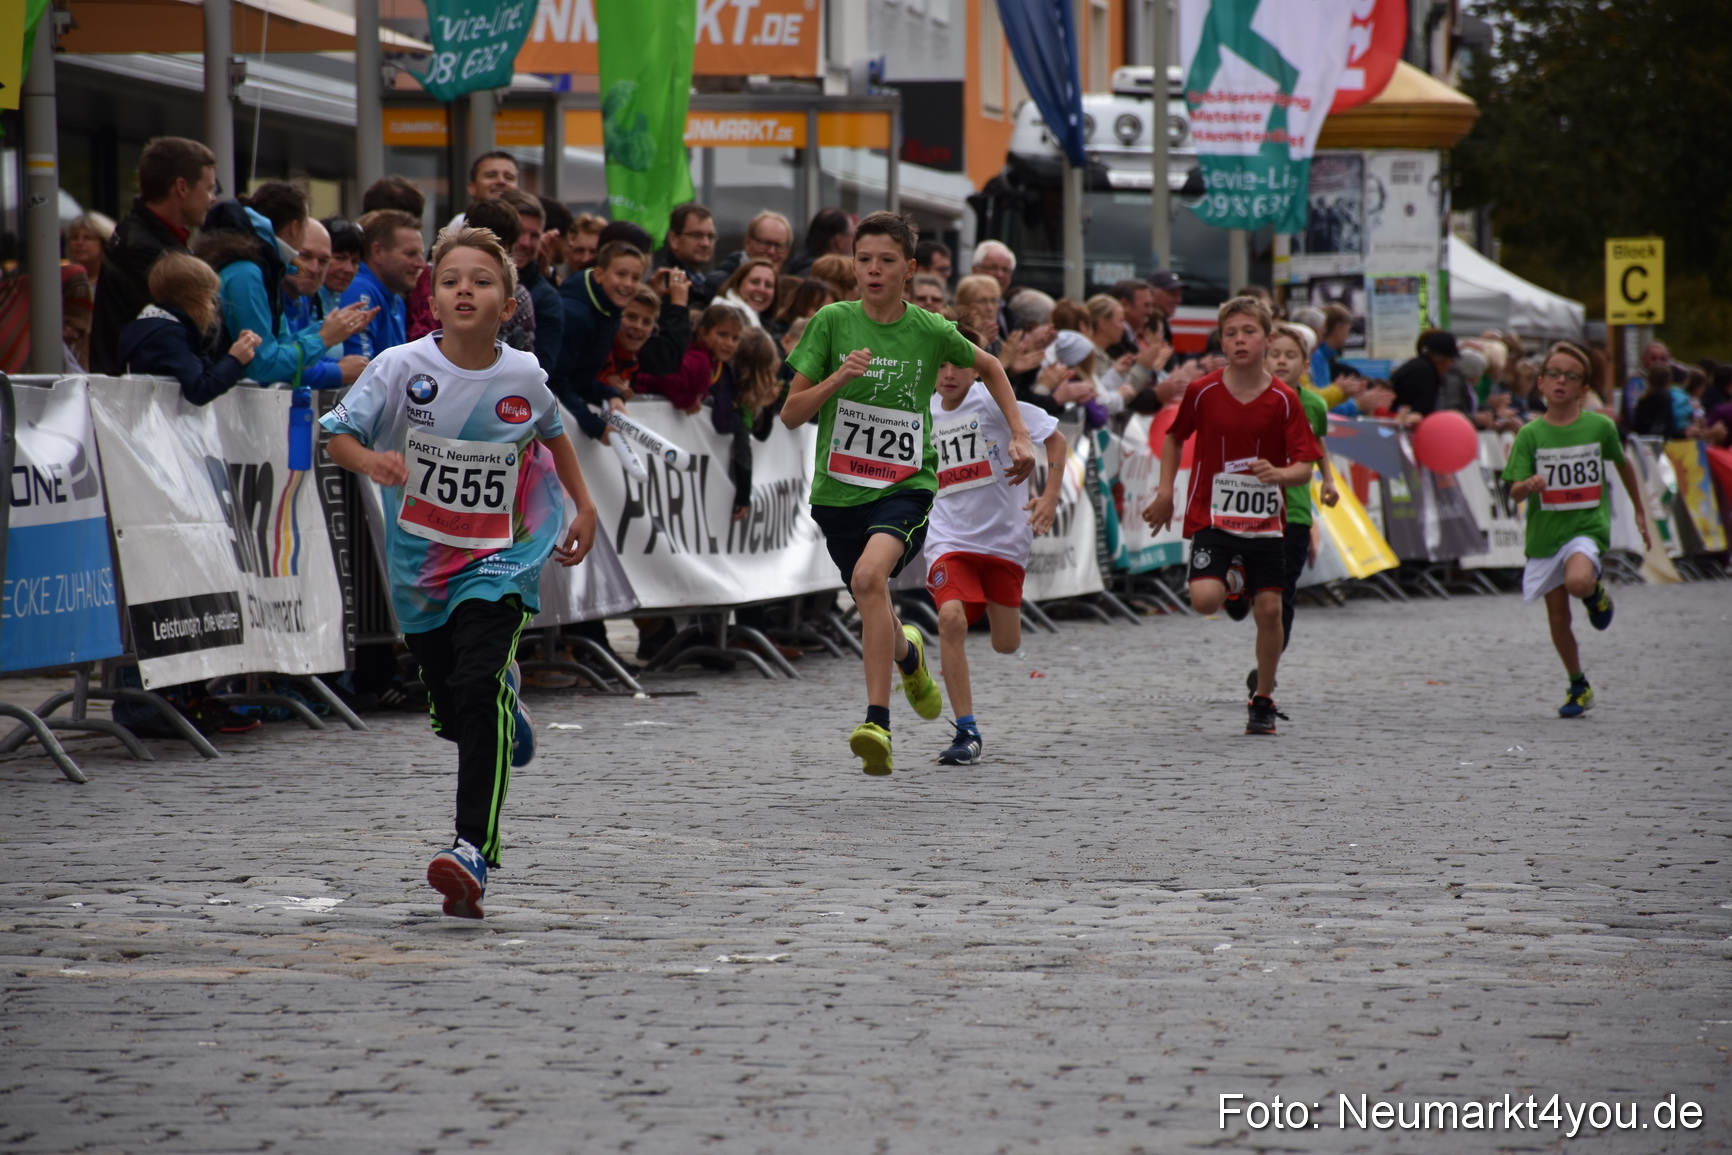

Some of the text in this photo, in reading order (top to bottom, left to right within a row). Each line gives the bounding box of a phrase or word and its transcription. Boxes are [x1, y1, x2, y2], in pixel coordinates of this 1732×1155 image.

[1613, 245, 1656, 259] Block
[1621, 265, 1648, 306] C
[406, 405, 436, 421] PARTL
[501, 402, 528, 418] Hervis
[838, 407, 909, 428] PARTL Neumarkt
[843, 420, 915, 462] 7129
[938, 424, 968, 437] Neumarkt
[408, 440, 502, 464] PARTL Neumarkt
[932, 432, 976, 466] 417
[850, 460, 897, 480] Valentin
[1543, 459, 1600, 487] 7083
[416, 457, 507, 509] 7555
[1214, 478, 1239, 488] PARTL
[1220, 489, 1279, 516] 7005
[152, 616, 203, 642] Leistungen,
